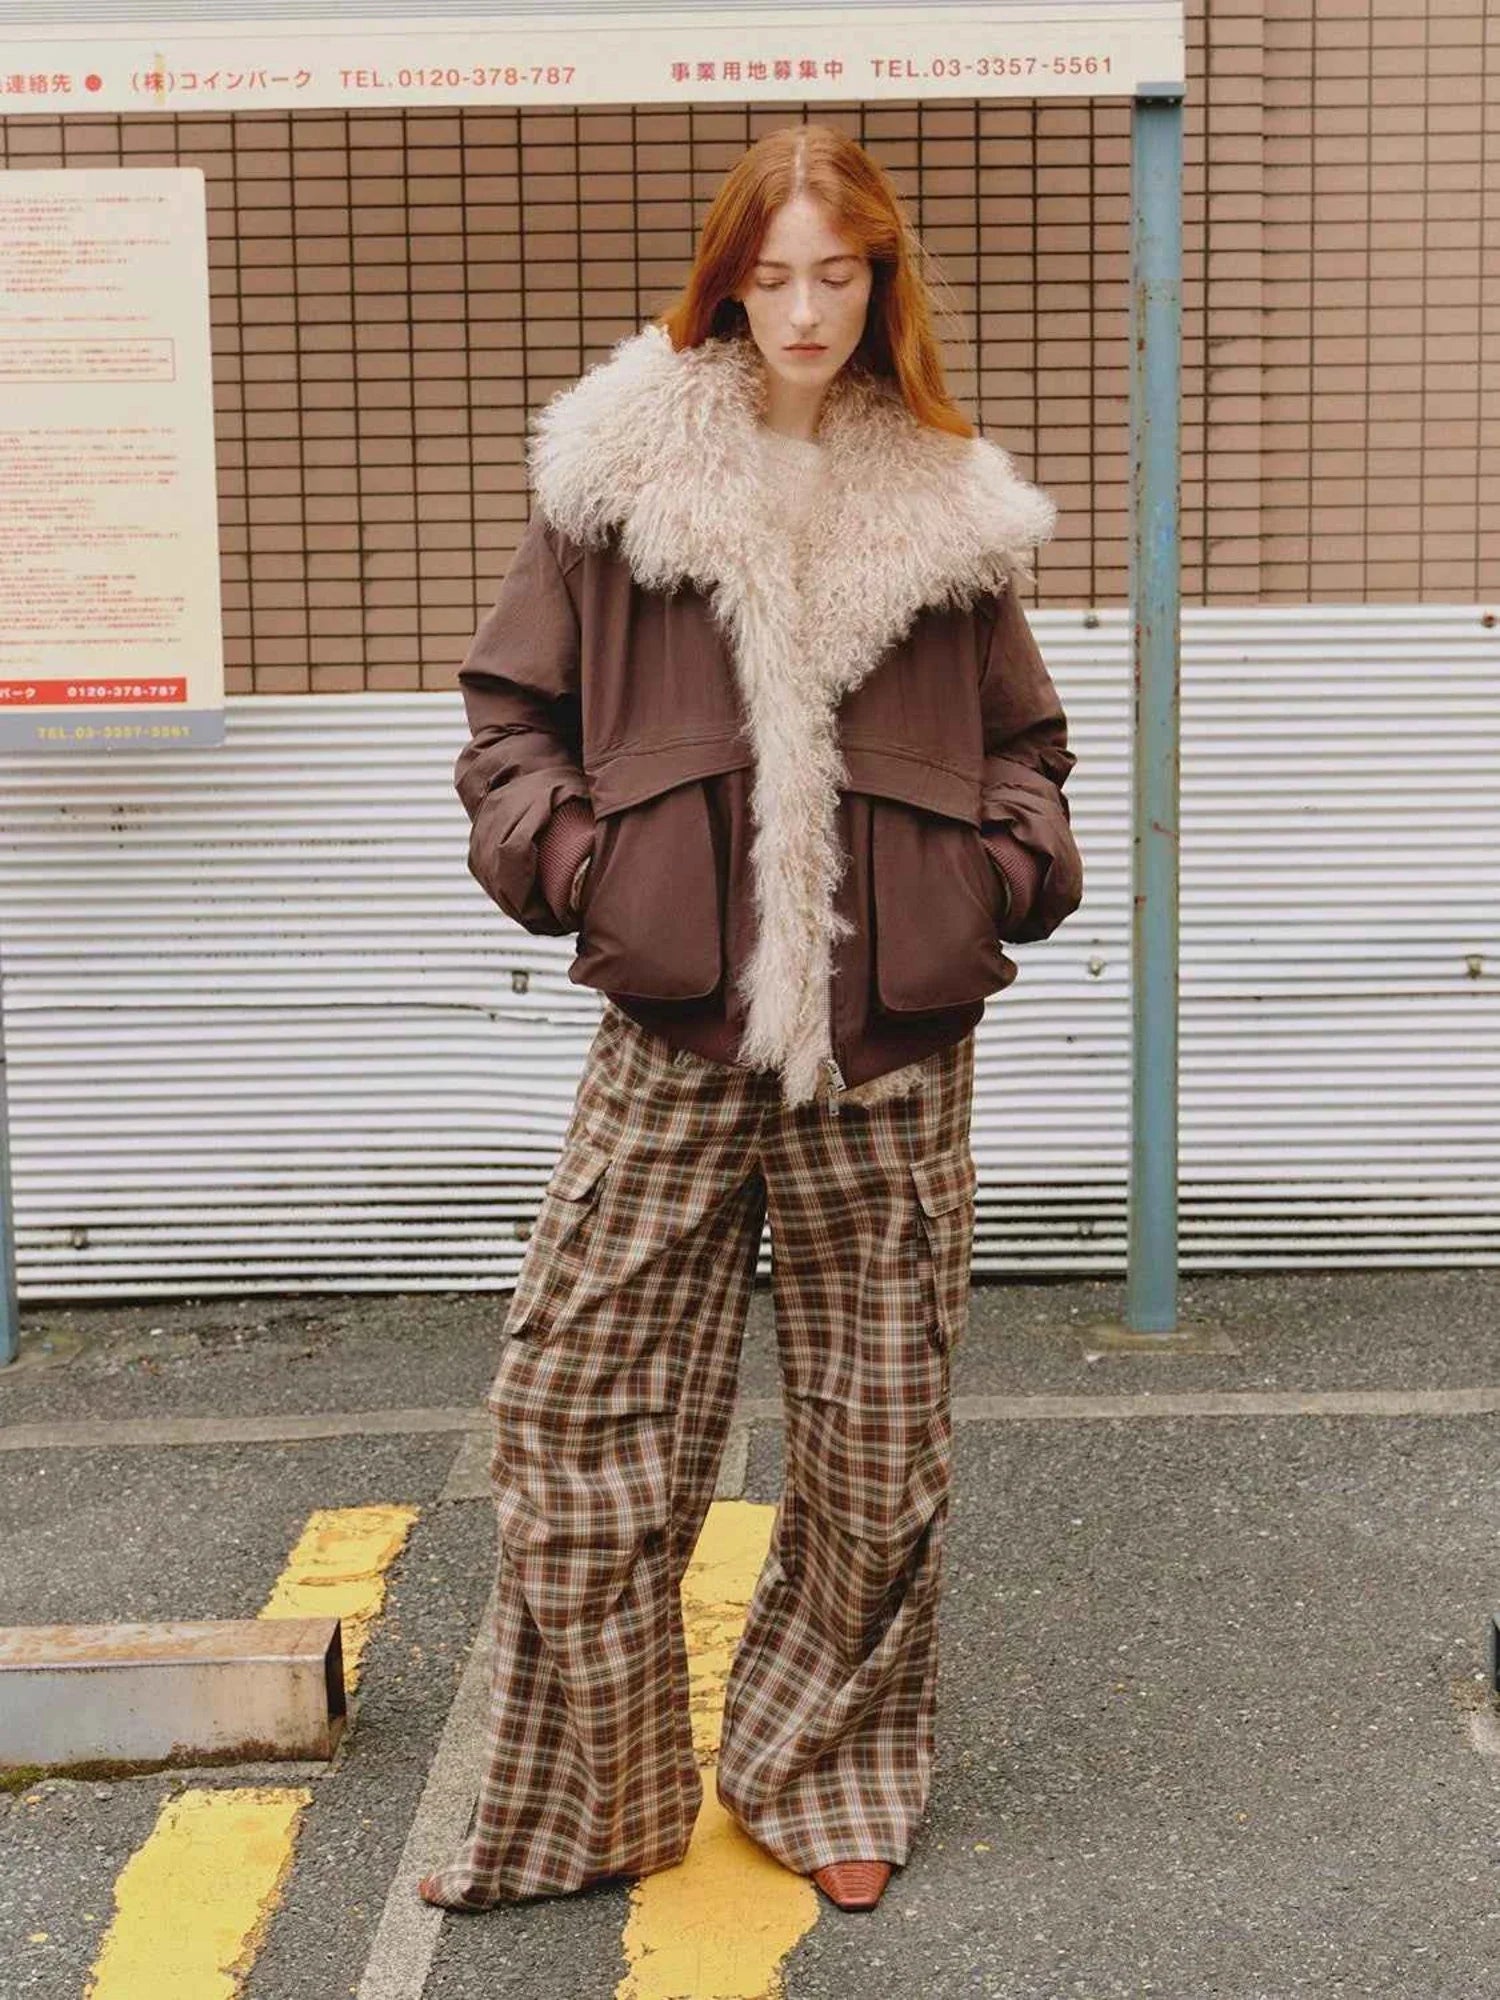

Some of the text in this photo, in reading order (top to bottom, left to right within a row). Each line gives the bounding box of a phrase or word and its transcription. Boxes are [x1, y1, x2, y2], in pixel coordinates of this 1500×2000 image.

[0, 73, 73, 94] 連絡先
[340, 67, 577, 88] TEL.0120-378-787
[671, 56, 1113, 82] 事業用地募集中 TEL.03-3357-5561
